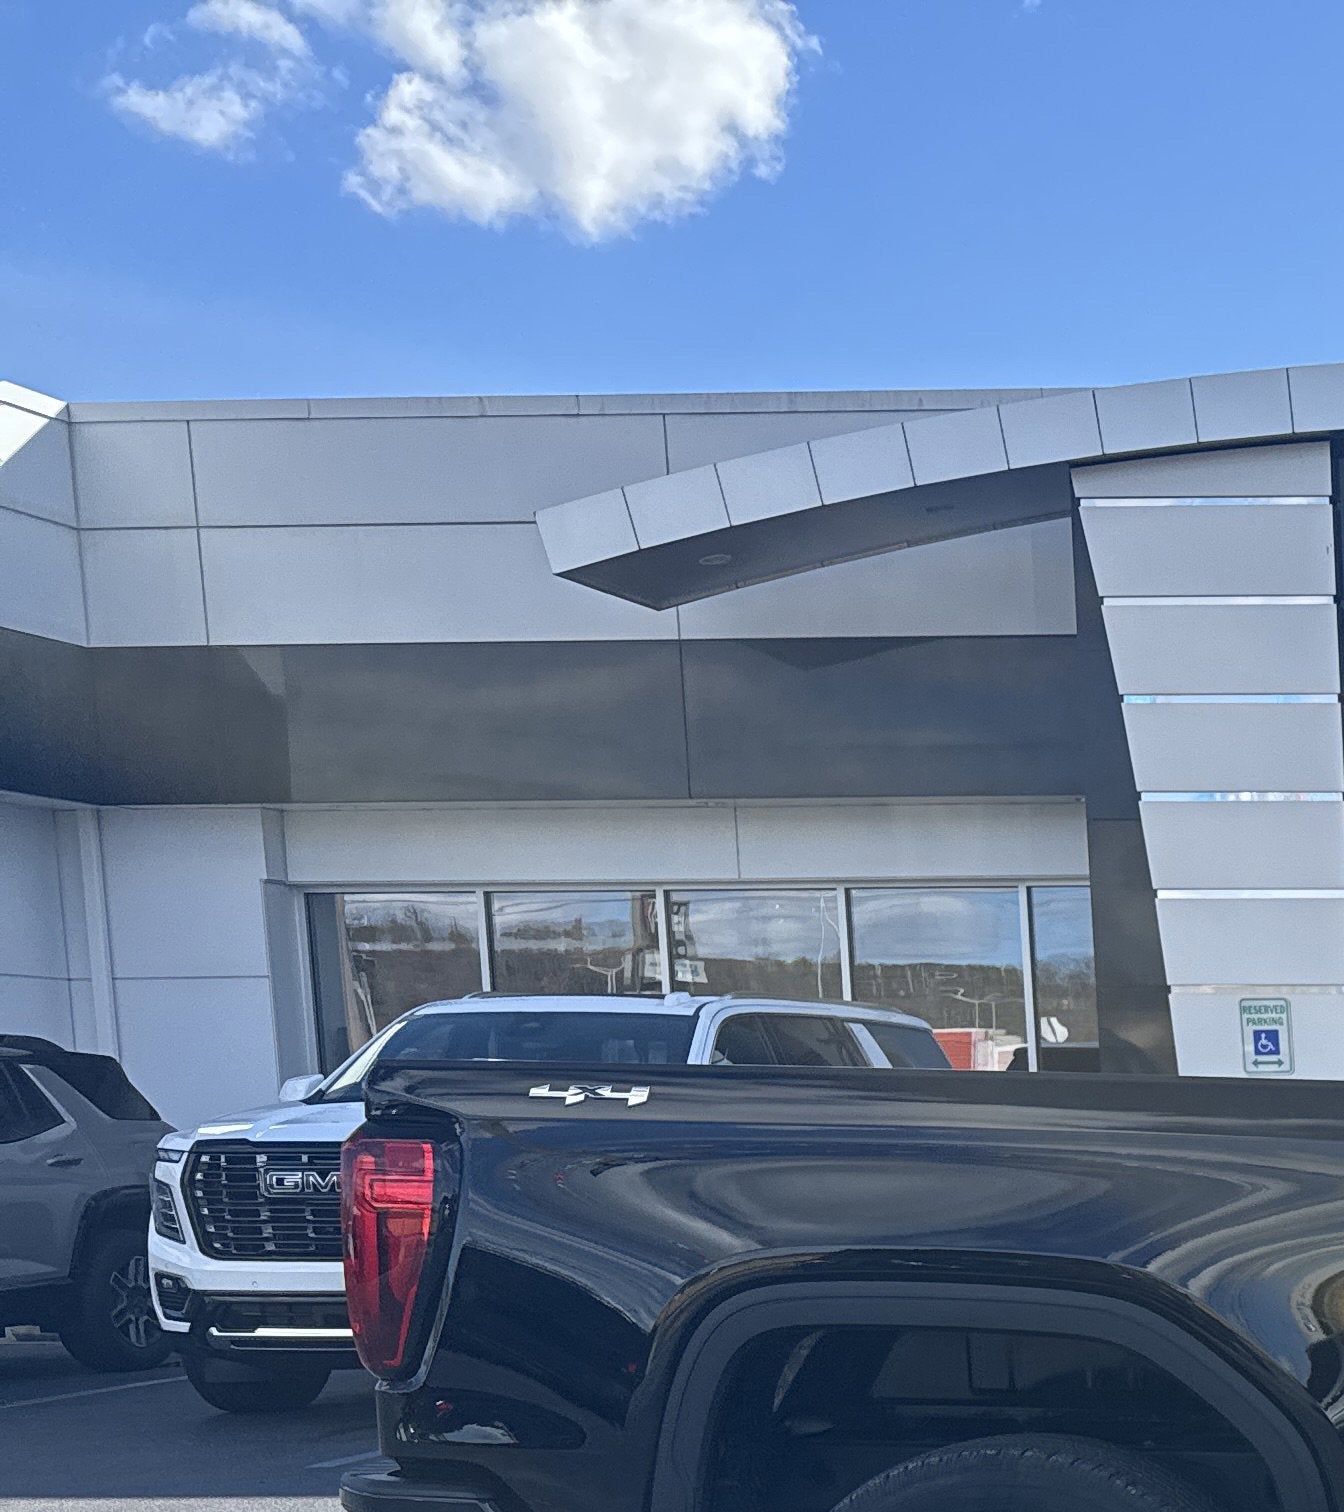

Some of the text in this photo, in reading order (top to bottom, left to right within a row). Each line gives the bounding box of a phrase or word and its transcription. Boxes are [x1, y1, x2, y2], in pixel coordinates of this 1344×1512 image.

[1242, 1004, 1286, 1015] RESERVED
[1246, 1016, 1284, 1027] PARKING
[266, 1171, 341, 1193] GM
